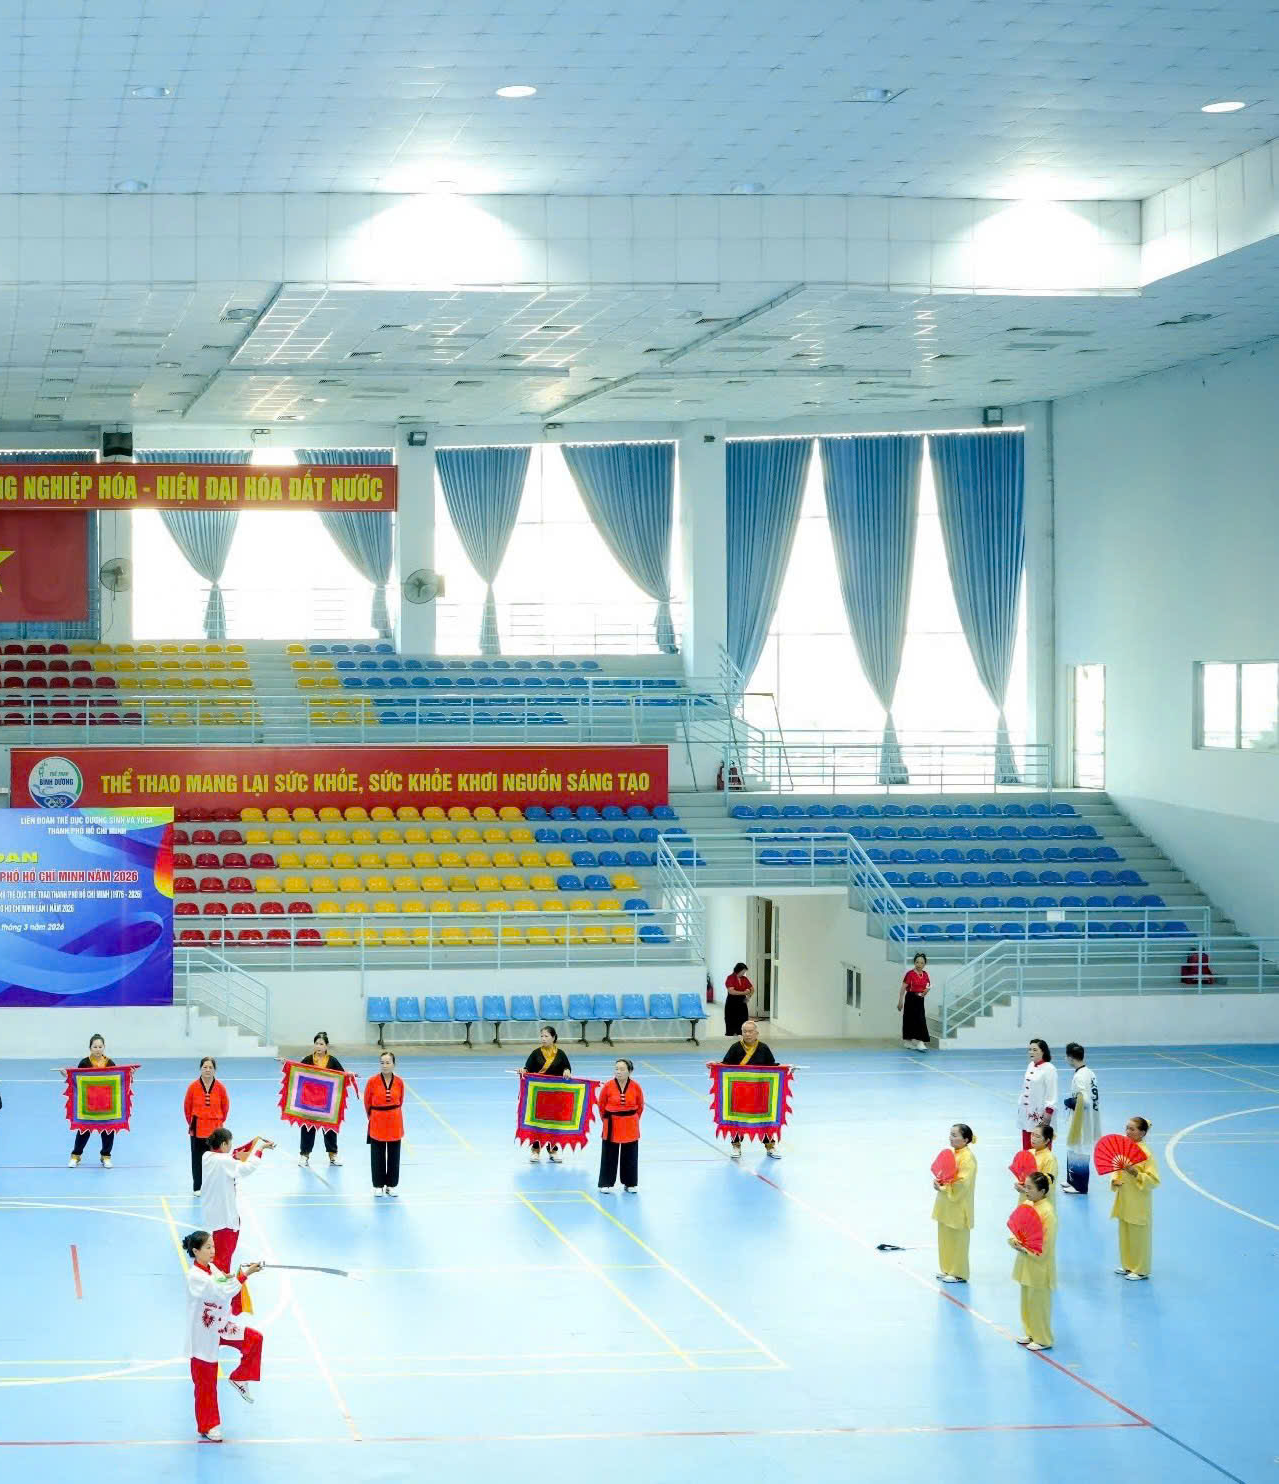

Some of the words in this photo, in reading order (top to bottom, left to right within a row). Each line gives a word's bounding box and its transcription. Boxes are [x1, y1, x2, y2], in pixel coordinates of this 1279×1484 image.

[24, 472, 92, 504] NGHIỆP
[98, 471, 137, 500] HÓA
[156, 472, 199, 504] HIỆN
[205, 476, 238, 505] ĐẠI
[245, 473, 282, 501] HÓA
[289, 469, 325, 501] ĐẤT
[331, 474, 383, 501] NƯỚC
[101, 768, 133, 793] THỂ
[137, 775, 181, 793] THAO
[186, 775, 238, 793] MANG
[243, 775, 269, 797] LẠI
[274, 770, 308, 792] SỨC
[314, 768, 363, 794] KHỎE,
[369, 770, 402, 792] SỨC
[408, 768, 452, 792] KHỎE
[503, 768, 562, 792] NGUỒN
[567, 769, 613, 792] SÁNG
[618, 773, 649, 795] TẠO
[0, 867, 20, 883] PHỐ
[22, 868, 36, 883] HỒ
[39, 869, 56, 883] CHÍ
[58, 870, 85, 883] MINH
[87, 868, 111, 883] NĂM
[113, 870, 138, 883] 2026
[48, 923, 64, 931] 2026
